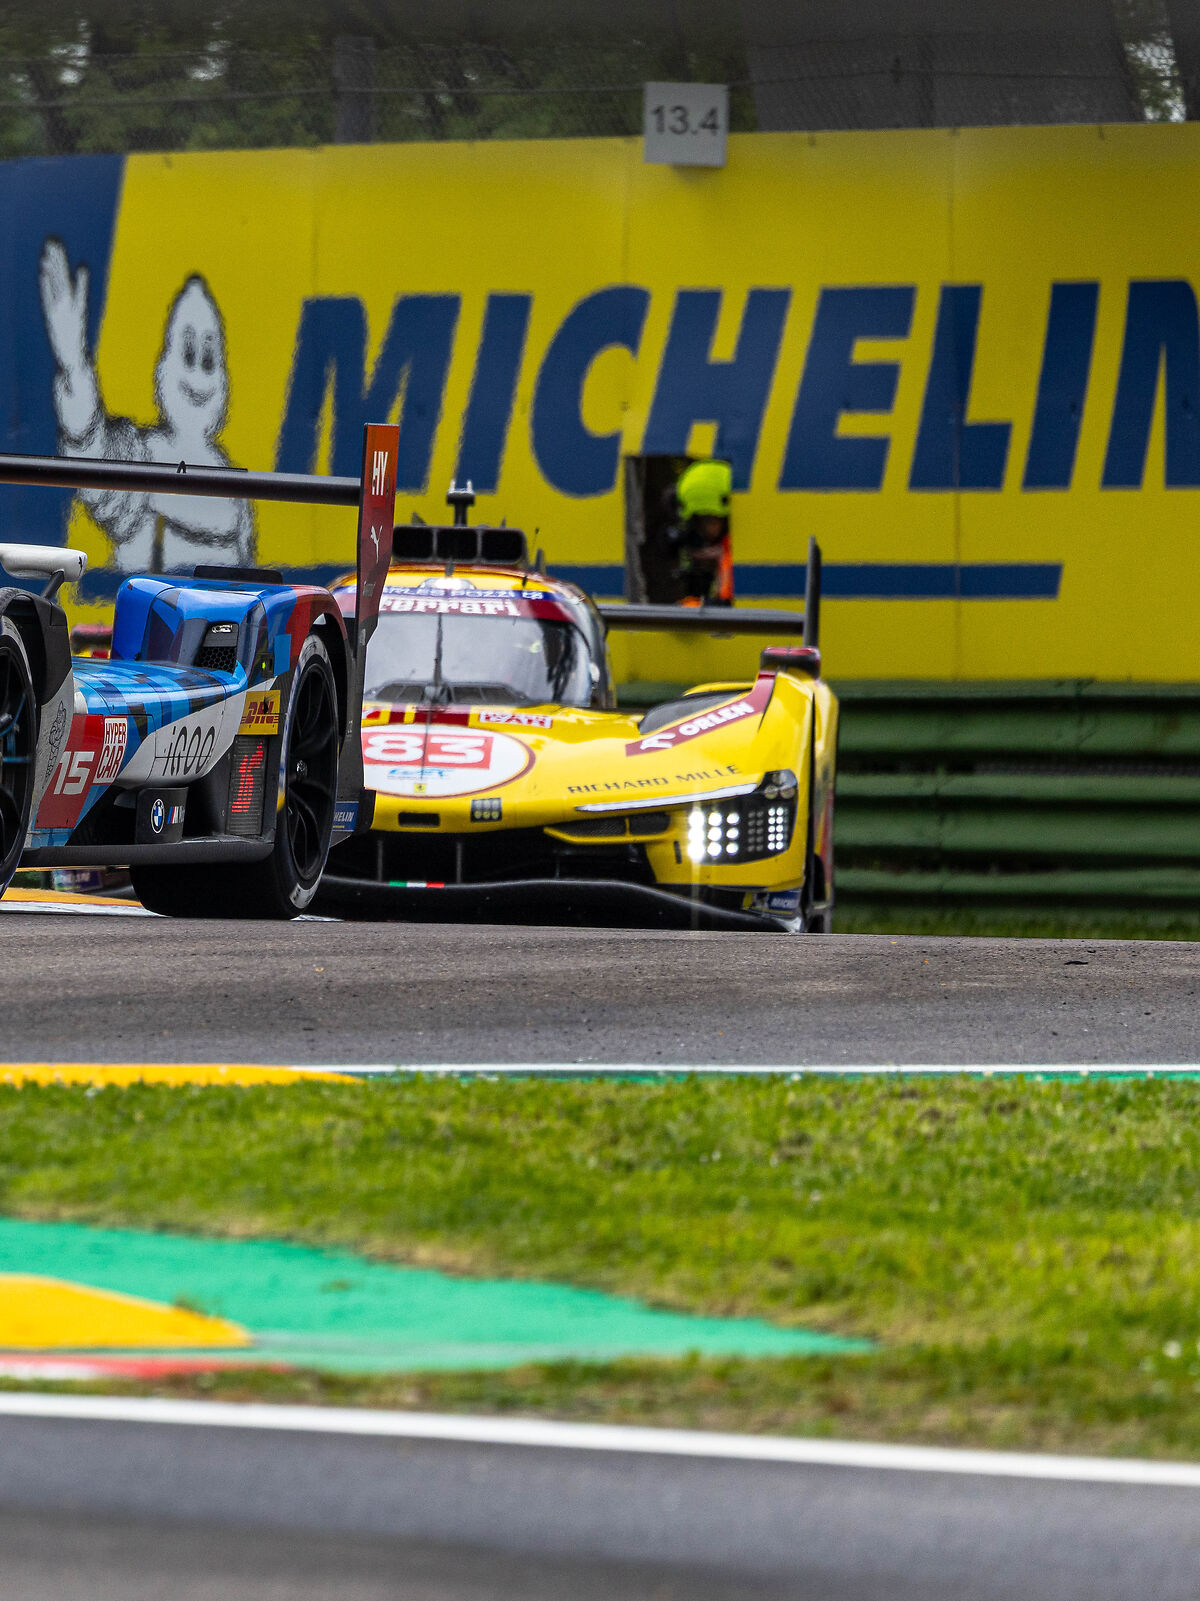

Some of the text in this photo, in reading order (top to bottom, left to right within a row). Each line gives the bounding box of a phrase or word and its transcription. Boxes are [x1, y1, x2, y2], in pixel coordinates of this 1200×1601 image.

[651, 105, 719, 136] 13.4
[372, 451, 388, 495] HY
[377, 597, 520, 616] Ferrari
[105, 722, 127, 744] HYPER
[678, 702, 755, 736] ORLEN
[97, 745, 124, 779] CAR
[364, 734, 485, 764] 83
[53, 751, 95, 795] 15
[568, 764, 742, 794] RICHARD MILLE
